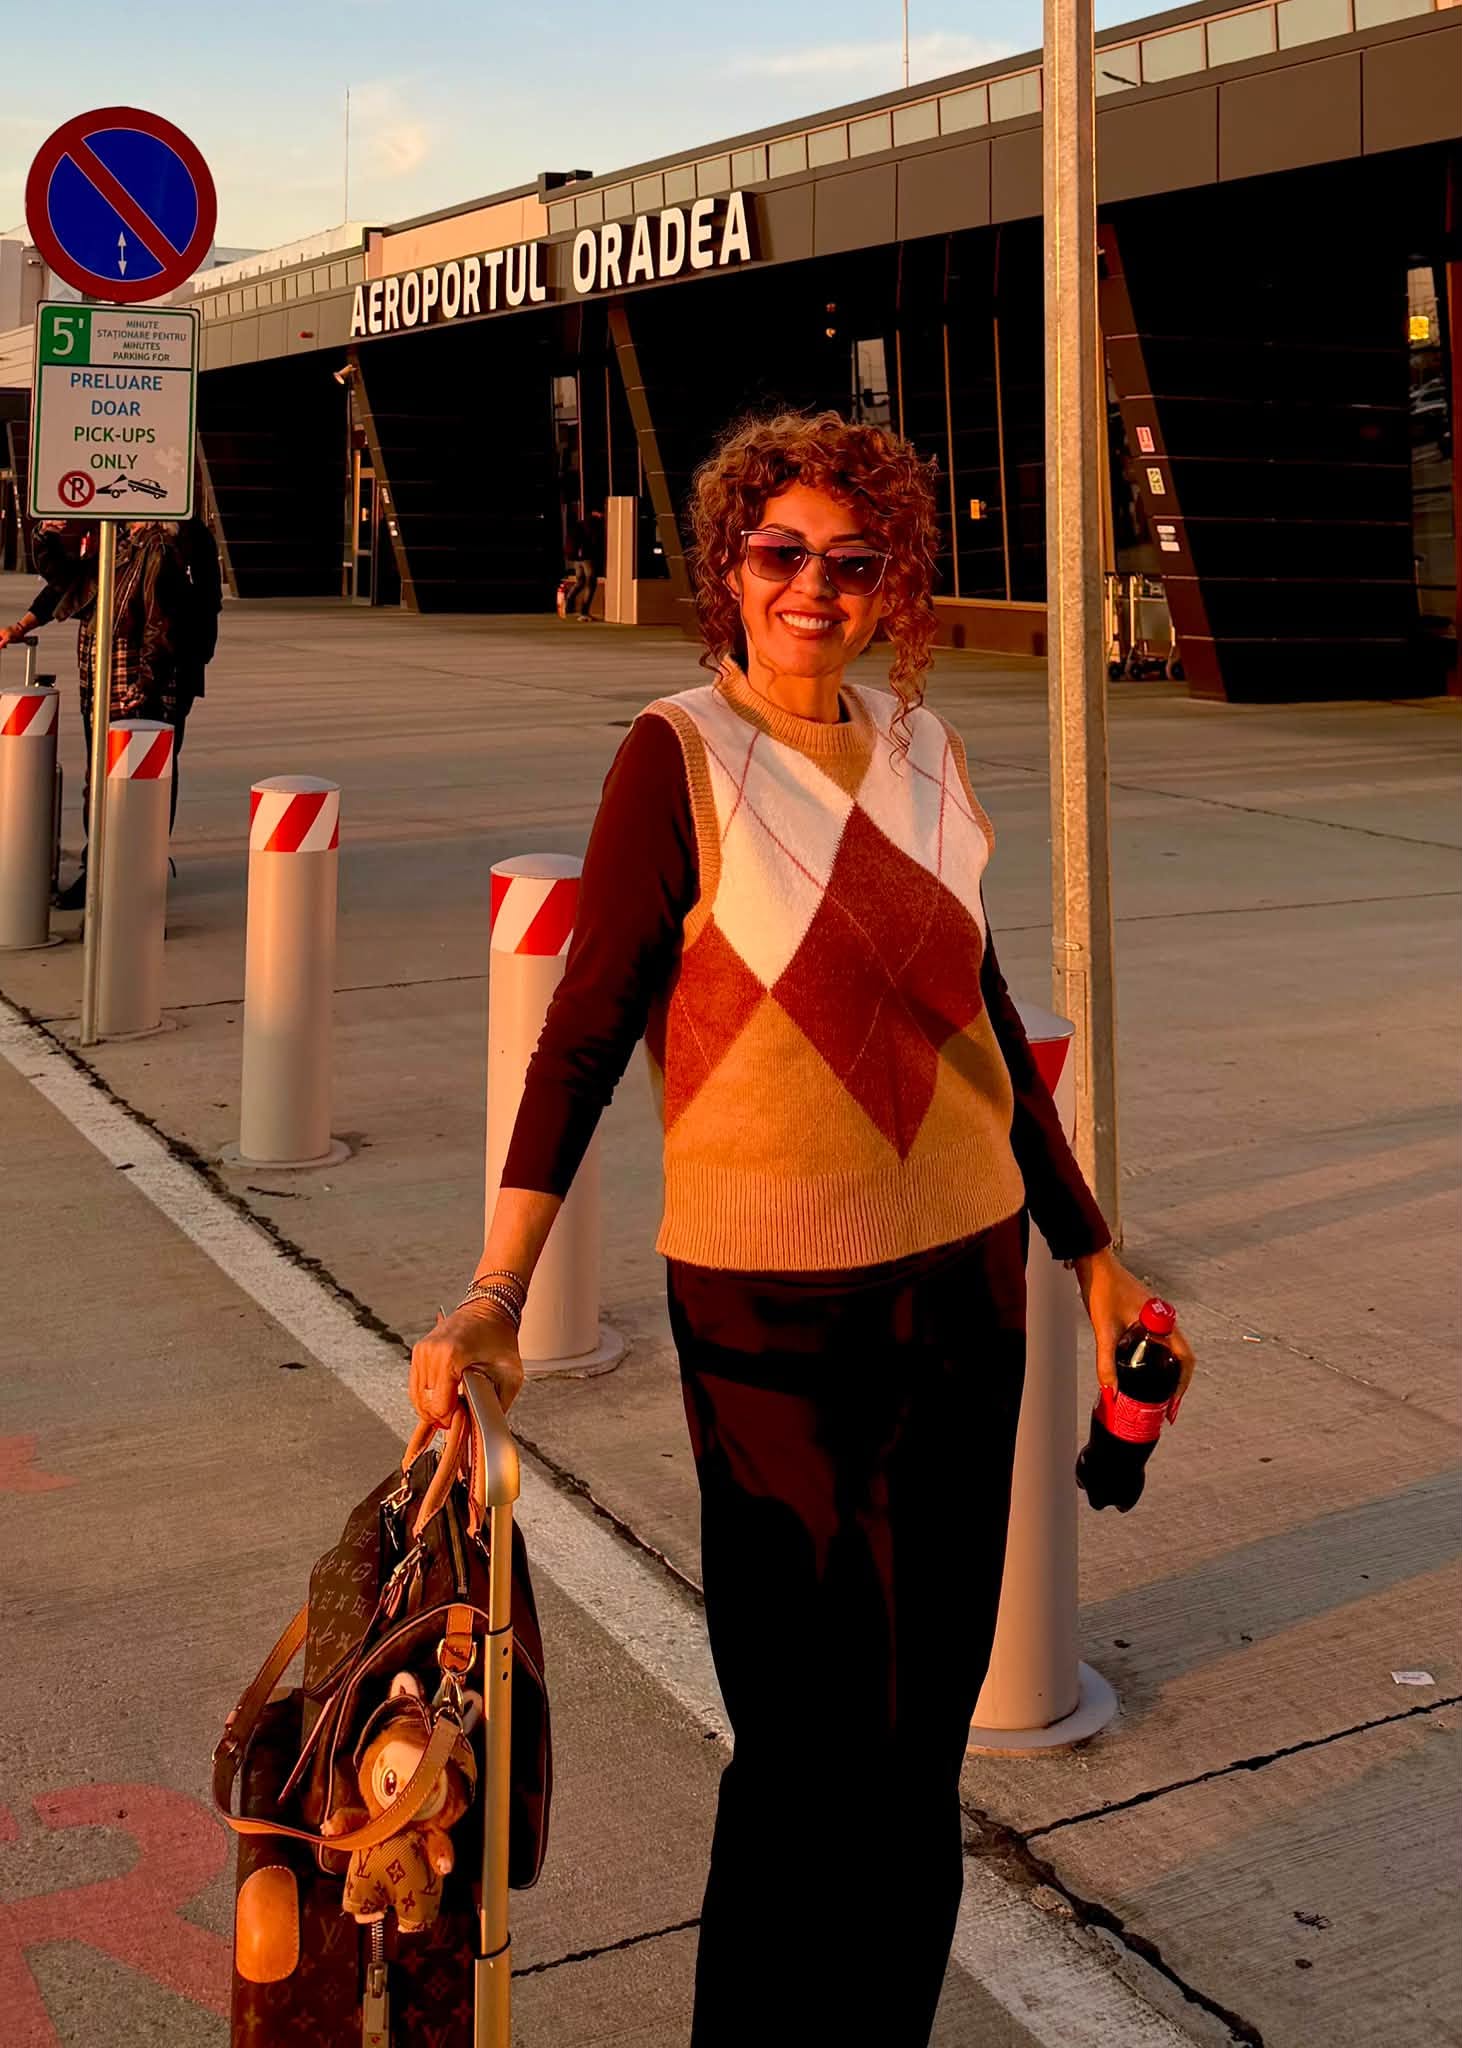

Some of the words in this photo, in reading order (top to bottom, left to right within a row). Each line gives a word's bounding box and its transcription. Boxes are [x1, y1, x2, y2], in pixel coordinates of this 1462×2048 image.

[349, 242, 546, 337] AEROPORTUL
[572, 191, 751, 294] ORADEA
[126, 320, 160, 329] MINUTE
[152, 331, 187, 341] PENTRU
[122, 342, 161, 351] MINUTES
[112, 351, 150, 361] PARKING
[152, 353, 170, 362] FOR
[70, 372, 163, 391] PRELUARE
[91, 400, 141, 416] DOAR
[74, 426, 156, 443] PICK-UPS
[90, 454, 138, 469] ONLY
